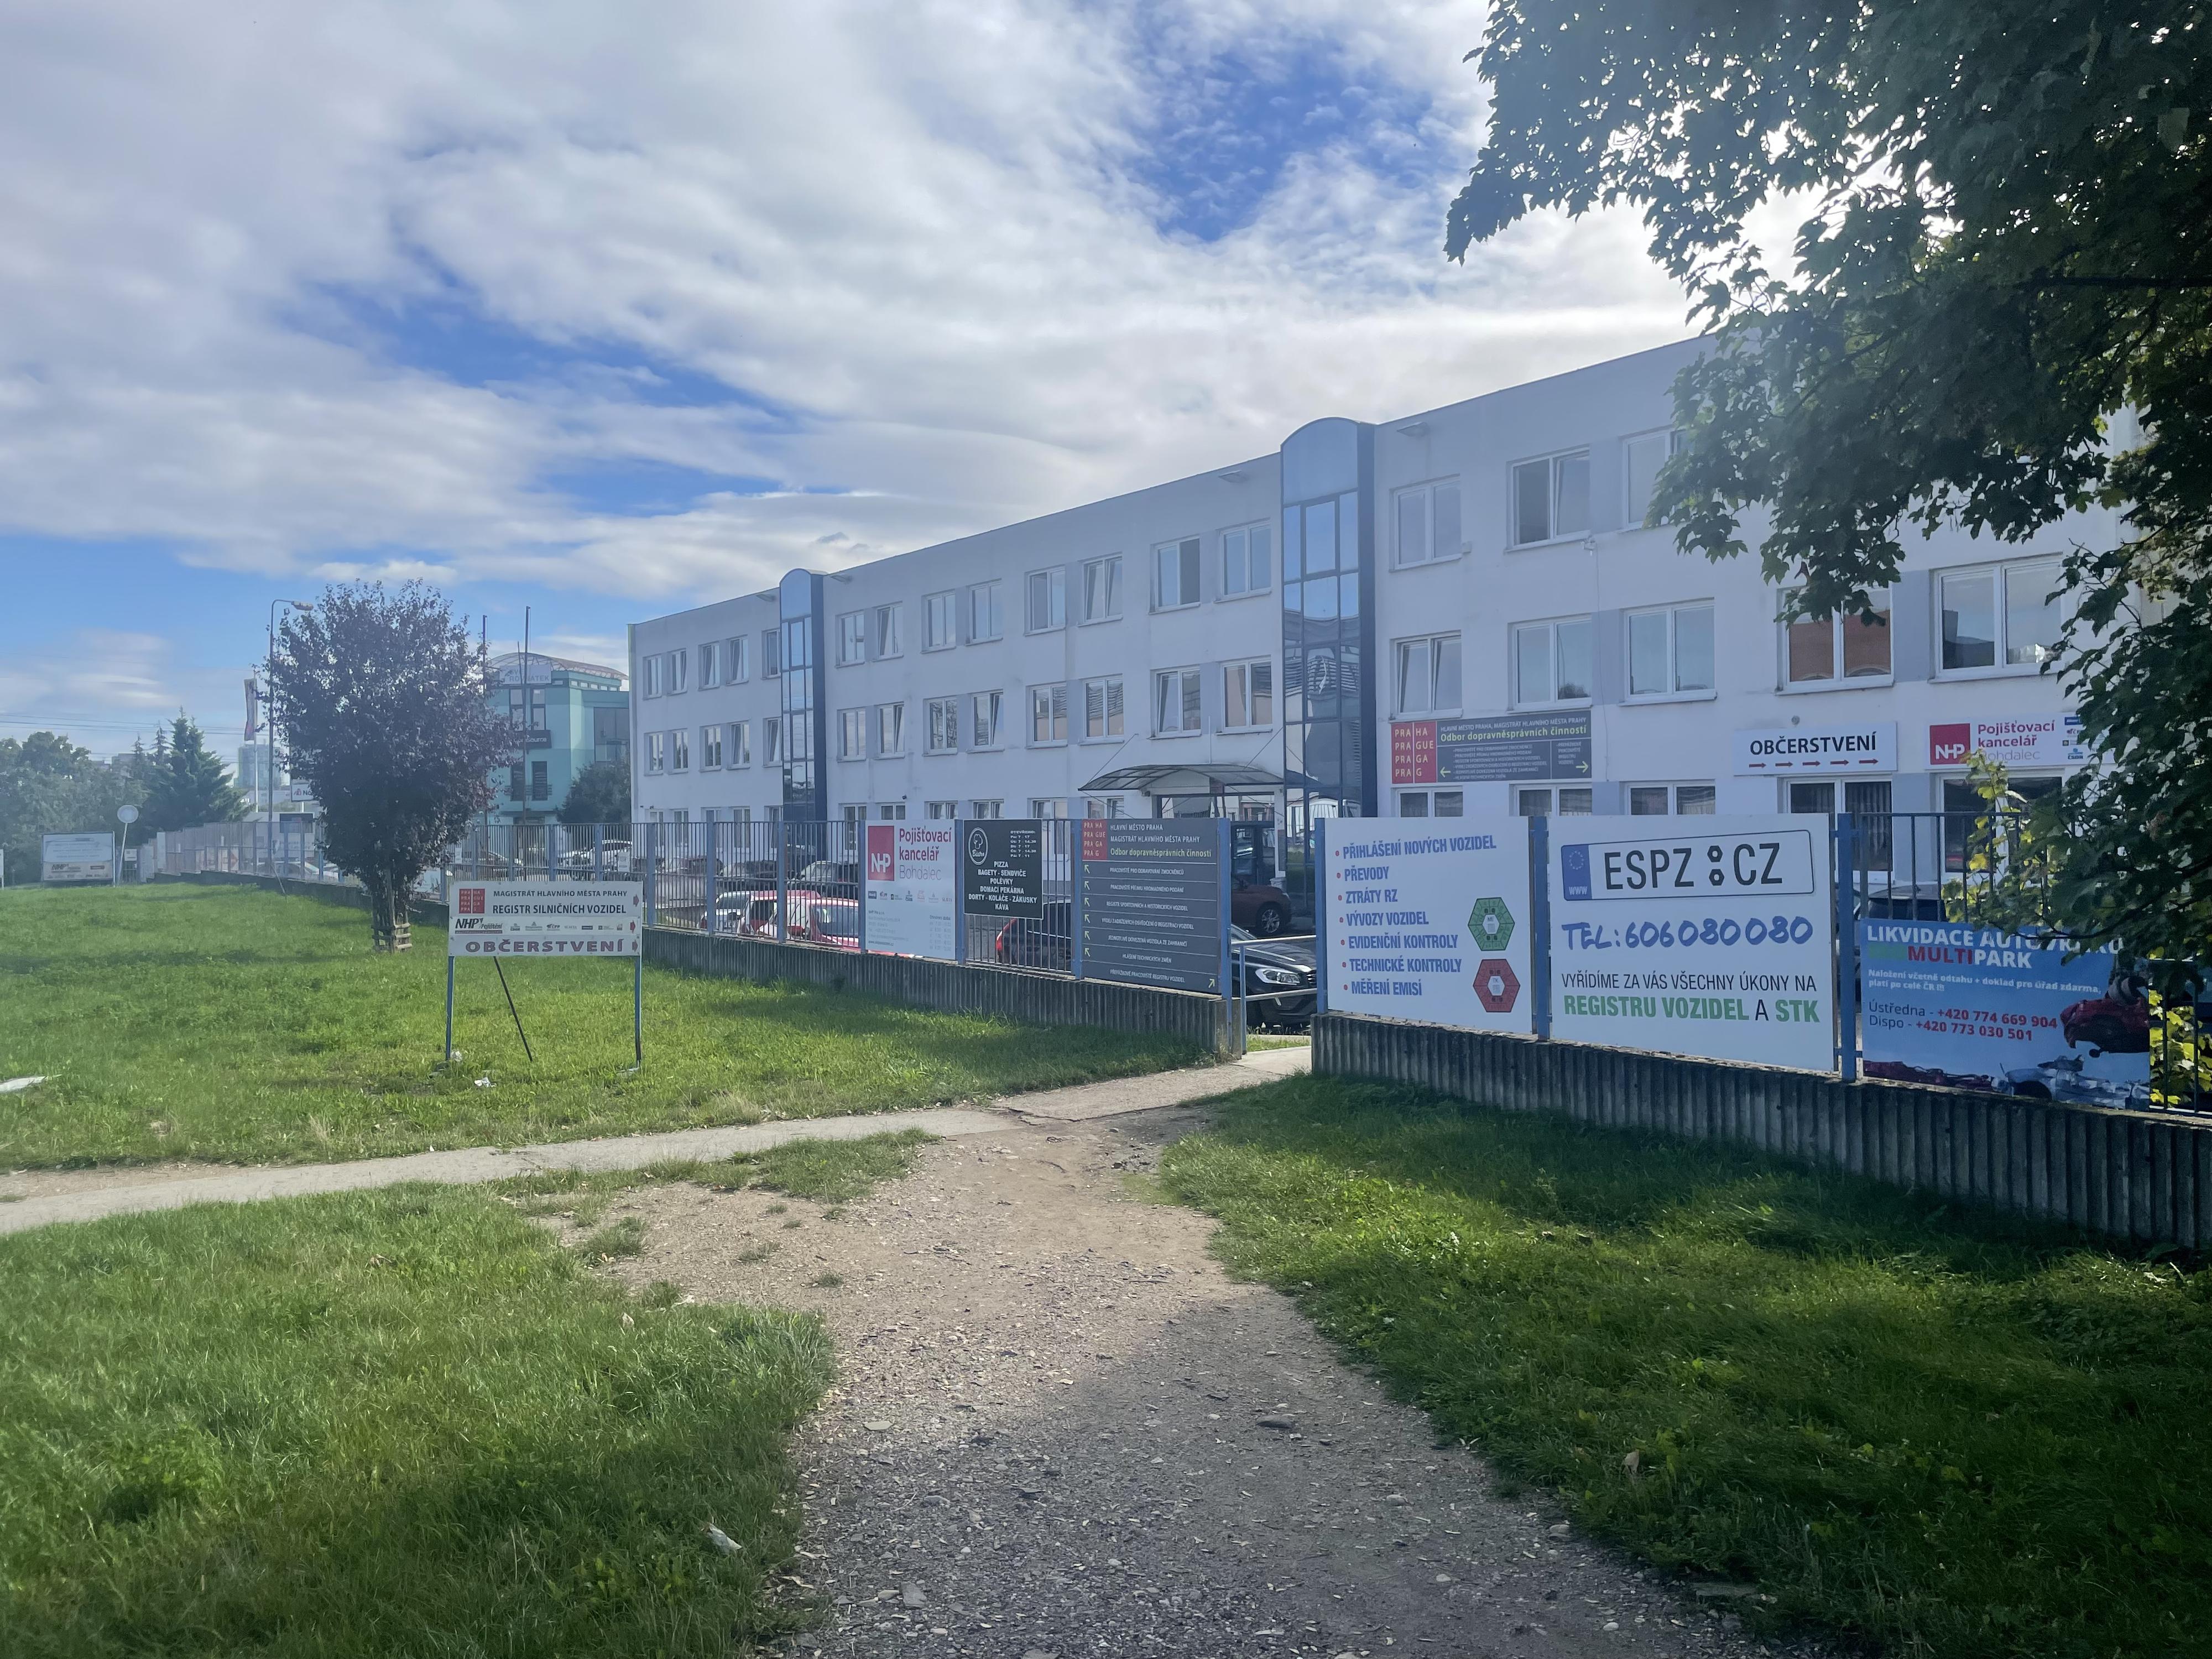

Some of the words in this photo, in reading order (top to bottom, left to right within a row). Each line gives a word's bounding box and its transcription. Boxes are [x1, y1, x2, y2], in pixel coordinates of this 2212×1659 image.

[1395, 729, 1411, 737] PRA
[1416, 727, 1427, 736] HA
[1441, 732, 1465, 742] Odbor
[1468, 727, 1548, 742] dopravněsprávních
[1551, 726, 1587, 736] činností
[1978, 720, 2055, 736] Pojišťovací
[1395, 742, 1411, 750] PRA
[1416, 740, 1434, 750] GUE
[1750, 731, 1877, 755] OBČERSTVENÍ
[1978, 734, 2037, 748] kancelář
[1395, 755, 1411, 764] PRA
[1416, 755, 1428, 763] GA
[1936, 743, 1965, 760] NHP
[1416, 768, 1422, 776] G
[899, 825, 952, 845] Pojišťovací
[899, 846, 940, 861] kancelář
[1129, 848, 1185, 858] dopravněsprávních
[1187, 849, 1212, 857] činností
[1343, 838, 1401, 859] PŘIHLÁŠENÍ
[1405, 836, 1447, 855] NOVÝCH
[1449, 835, 1496, 851] VOZIDEL
[871, 853, 891, 873] NHP
[1604, 848, 1694, 890] ESPZ
[1733, 843, 1782, 886] CZ
[899, 865, 942, 880] Bohdalec
[1344, 864, 1390, 881] PŘEVODY
[1000, 886, 1025, 894] PEKÁRNA
[1345, 887, 1382, 904] ZTRÁTY
[1385, 889, 1398, 903] RZ
[988, 894, 1009, 902] KOLÁČE
[1013, 895, 1037, 904] ZÁKUSKY
[493, 905, 530, 914] REGISTR
[533, 903, 585, 914] SILNIČNÍCH
[587, 905, 627, 914] VOZIDEL
[455, 918, 479, 929] NHP
[1347, 910, 1384, 926] VÝVOZY
[1387, 911, 1429, 925] VOZIDEL
[1349, 932, 1401, 949] EVIDENČNÍ
[1404, 935, 1458, 949] KONTROLY
[1867, 925, 1974, 947] LIKVIDACE
[466, 938, 624, 953] OBČERSTVENÍ
[1349, 955, 1405, 972] TECHNICKÉ
[1407, 958, 1462, 973] KONTROLY
[1908, 946, 2032, 969] MULTIPARK
[1352, 978, 1390, 995] MĚŘENÍ
[1393, 978, 1422, 996] EMISÍ
[1561, 970, 1619, 989] VYŘÍDÍME
[1624, 974, 1640, 989] ZA
[1643, 971, 1668, 989] VÁS
[1671, 971, 1734, 991] VŠECHNY
[1739, 970, 1790, 992] ÚKONY
[1795, 975, 1817, 992] NA
[1868, 969, 1906, 979] Naložení
[1908, 972, 1938, 981] včetně
[1940, 974, 1973, 984] odtahu
[1982, 977, 2015, 987] doklad
[2016, 981, 2033, 989] pro
[2035, 980, 2058, 990] úřad
[1869, 979, 1889, 988] platí
[1923, 980, 1936, 991] ČR
[1564, 995, 1656, 1018] REGISTRU
[1662, 997, 1749, 1021] VOZIDEL
[1755, 999, 1769, 1021] A
[1775, 999, 1820, 1023] STK
[1869, 999, 1926, 1017] Ústředna
[1938, 1008, 1969, 1021] +420
[1973, 1010, 1997, 1023] 774
[2001, 1013, 2027, 1026] 669
[2031, 1015, 2058, 1029] 904
[1869, 1015, 1904, 1030] Dispo
[1916, 1020, 1947, 1032] +420
[1951, 1022, 1975, 1035] 773
[1979, 1025, 2004, 1038] 030
[2007, 1027, 2032, 1041] 501
